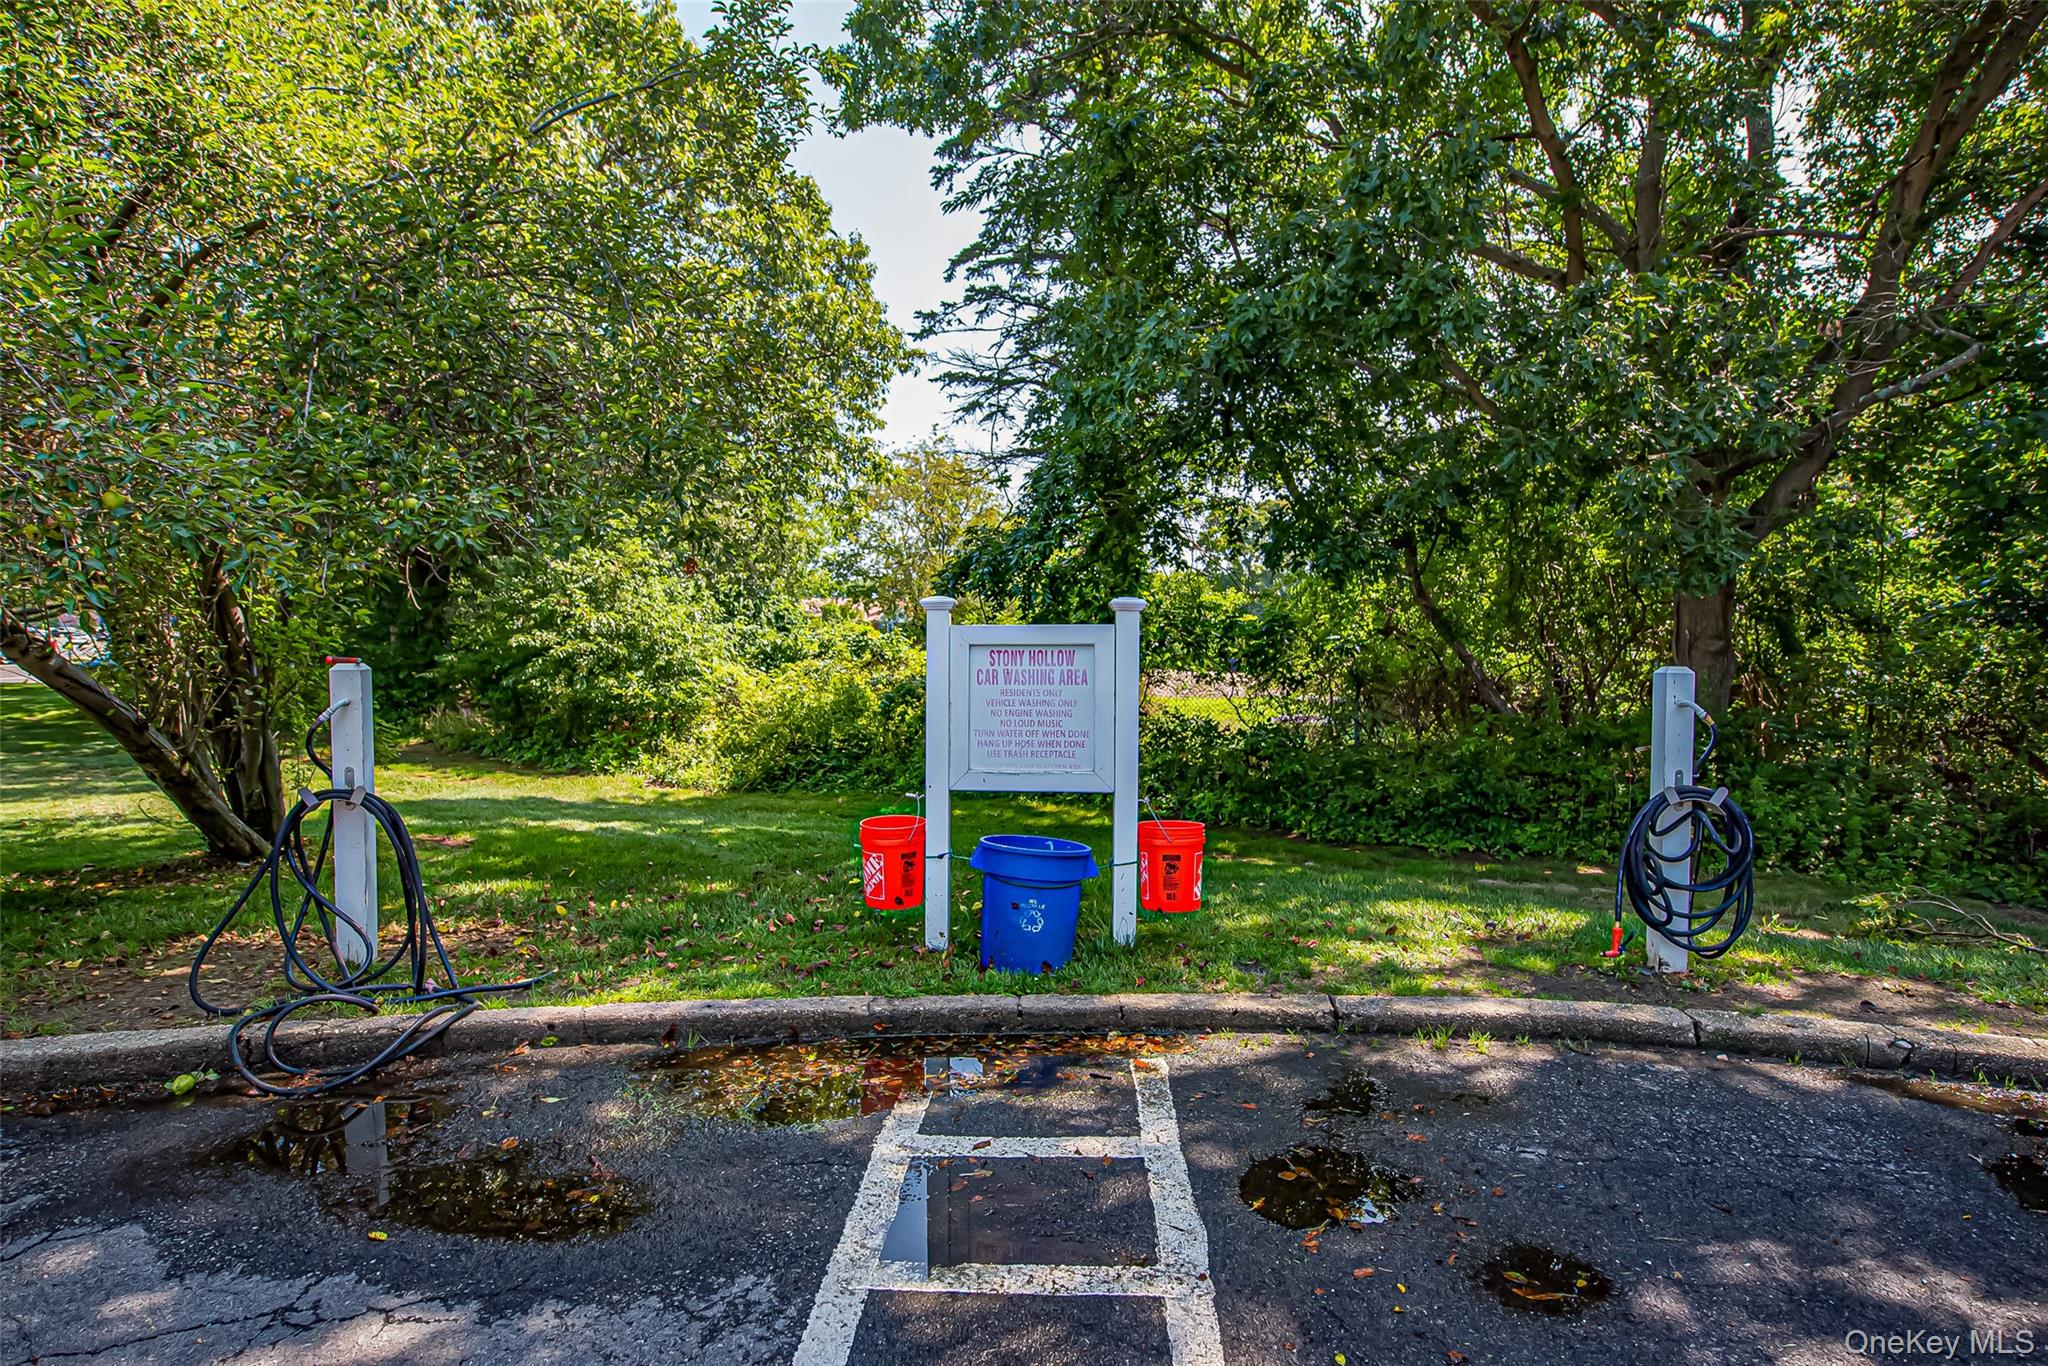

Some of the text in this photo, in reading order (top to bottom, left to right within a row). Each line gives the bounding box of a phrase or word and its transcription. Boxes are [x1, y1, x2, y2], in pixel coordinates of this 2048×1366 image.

[989, 649, 1076, 667] STONY HOLLOW
[976, 668, 1088, 686] CAR WASHING AREA
[1000, 688, 1063, 697] RESIDENTS ONLY
[985, 698, 1078, 707] VEHICLE WASHING ONLY
[990, 709, 1073, 718] NO ENGINE WASHING
[1000, 719, 1063, 728] NO LOUD MUSIC
[974, 729, 1091, 739] TURN WATER OFF WHEN DONE
[977, 739, 1086, 749] HANG UP HOSE WHEN DONE
[986, 750, 1076, 759] USE TRASH RECEPTACLE
